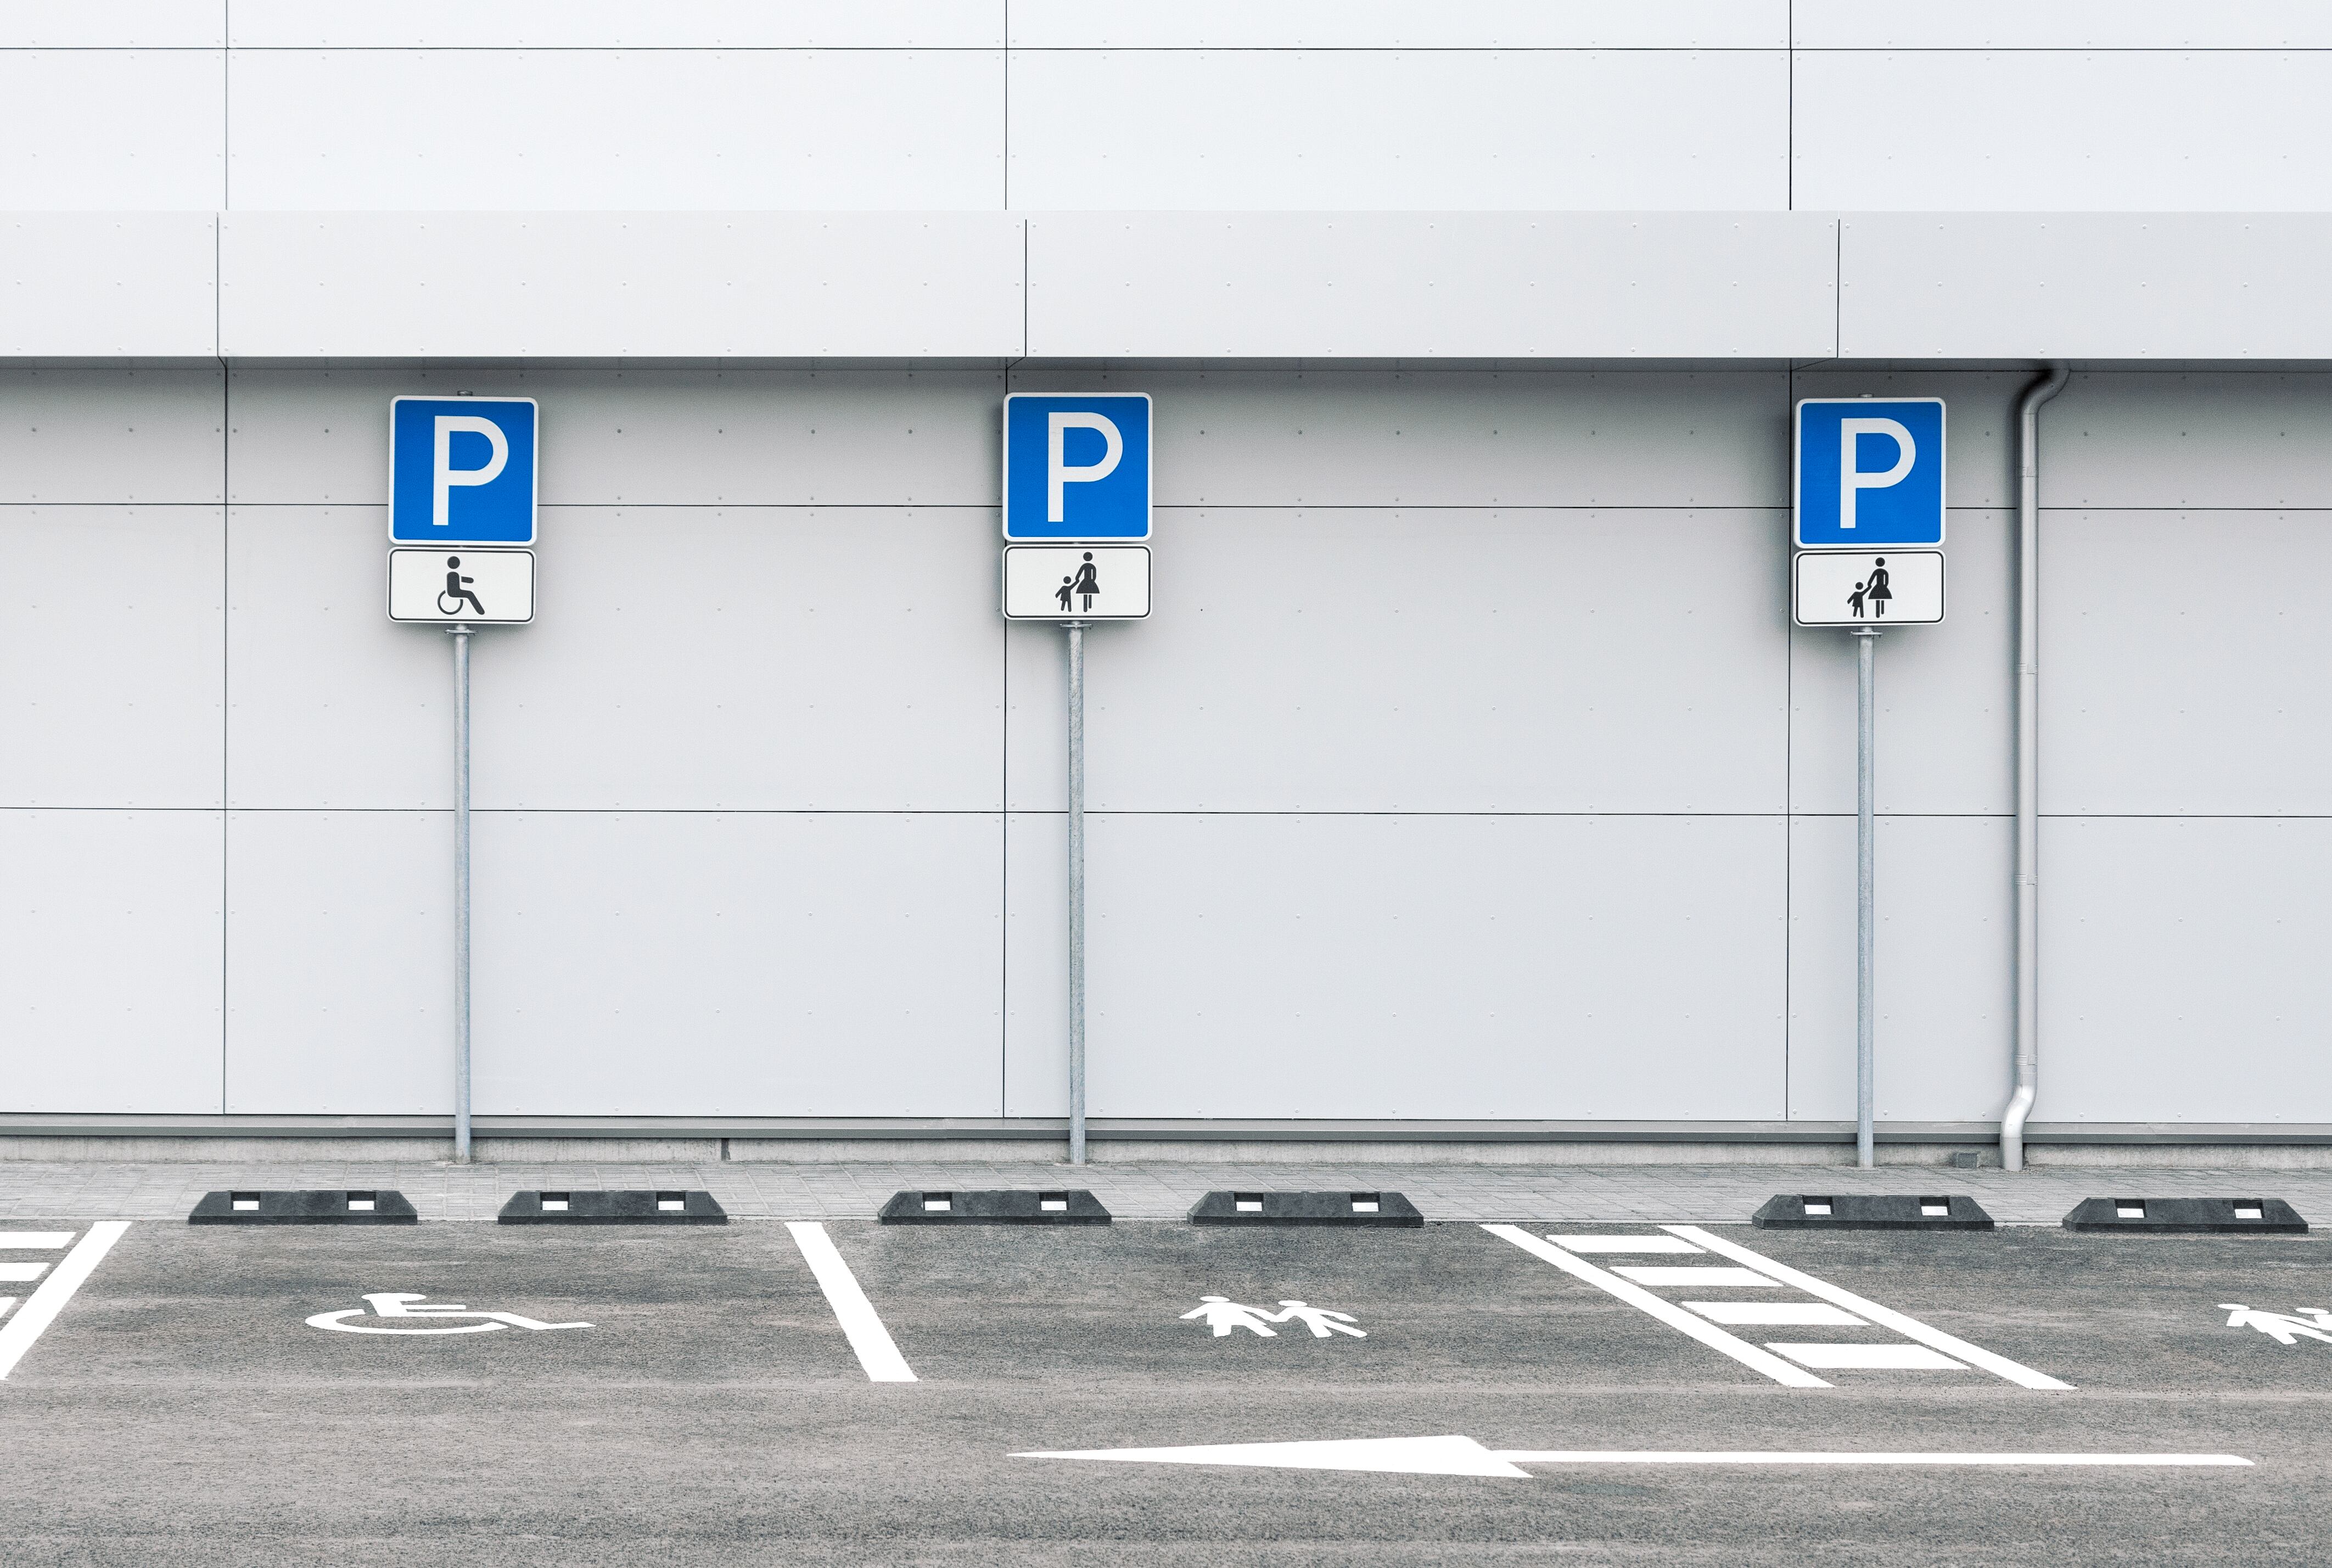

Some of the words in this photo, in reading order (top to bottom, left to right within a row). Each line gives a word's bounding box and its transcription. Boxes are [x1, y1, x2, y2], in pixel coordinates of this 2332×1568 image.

[433, 416, 508, 525] P
[1048, 412, 1123, 522] P
[1840, 418, 1916, 529] P
